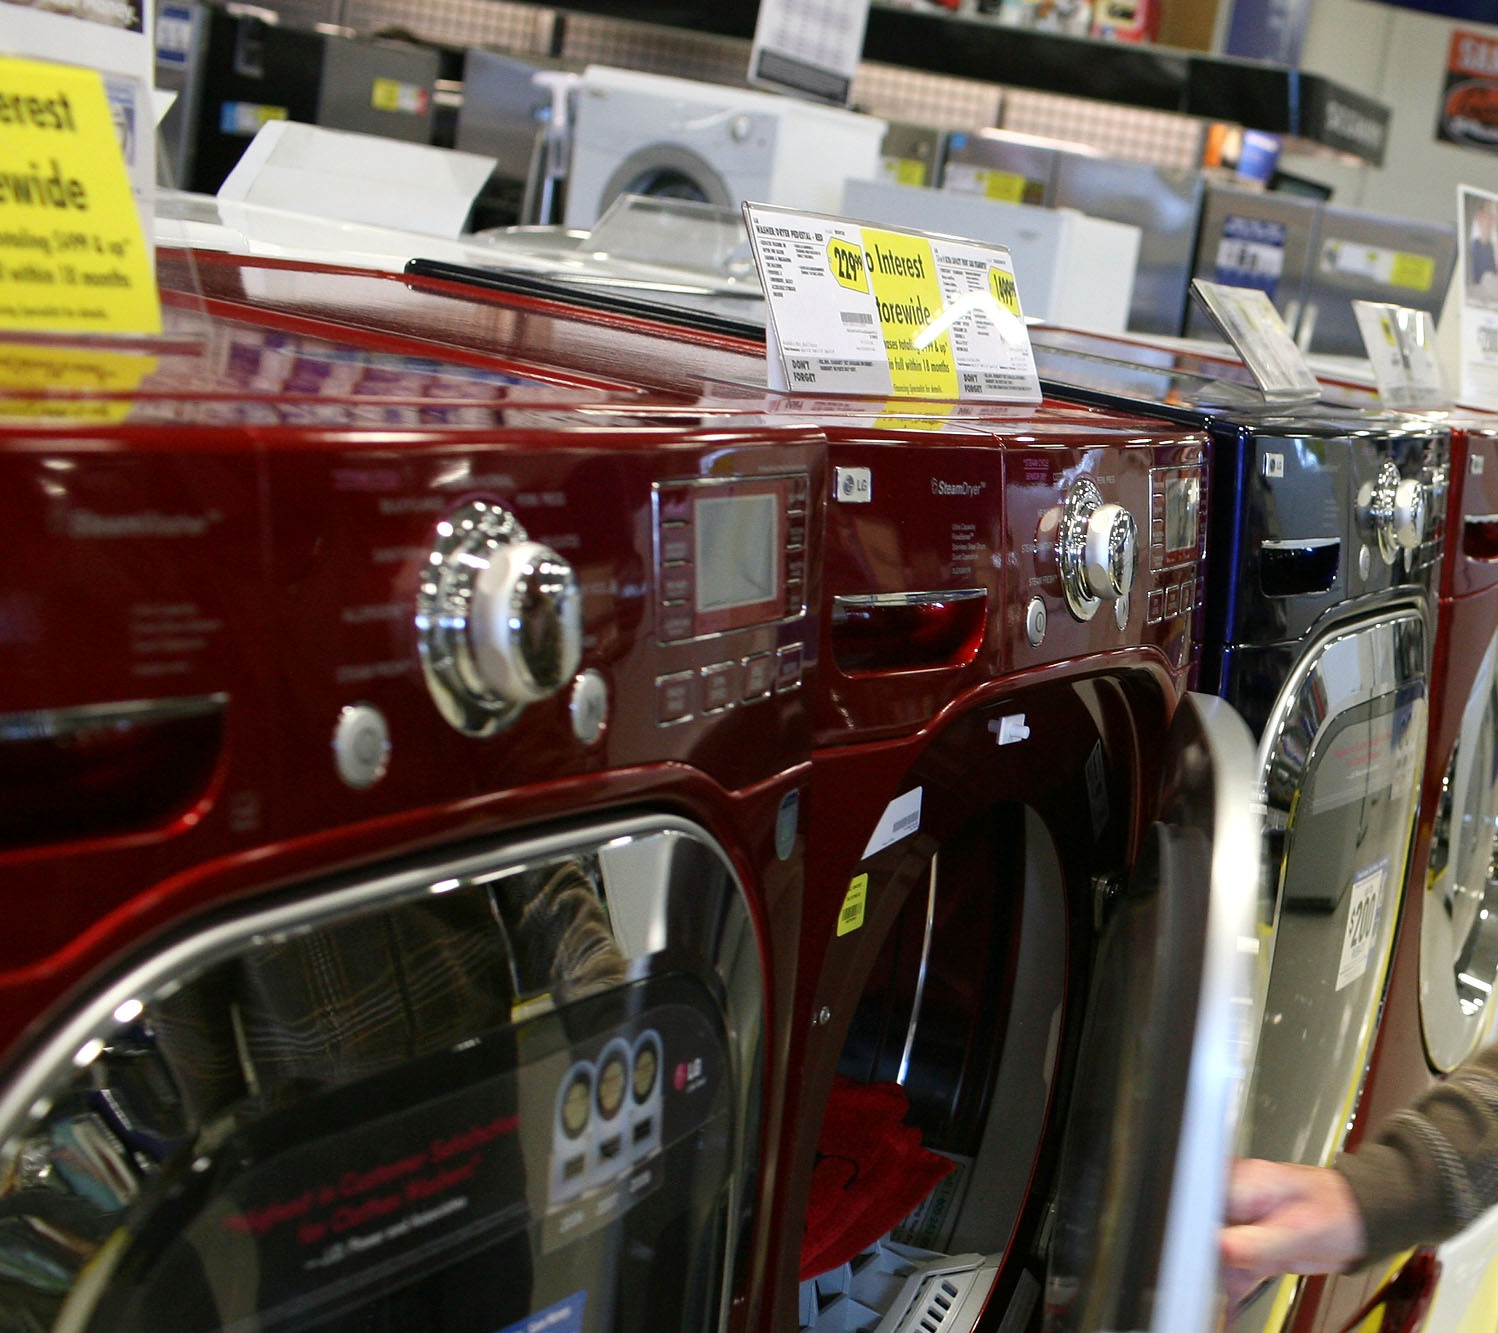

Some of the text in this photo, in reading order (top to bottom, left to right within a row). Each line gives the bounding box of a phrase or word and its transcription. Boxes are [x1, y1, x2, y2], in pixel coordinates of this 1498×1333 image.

[875, 243, 925, 279] Interest
[905, 357, 922, 371] within
[857, 480, 867, 492] LG
[1349, 892, 1376, 948] $200
